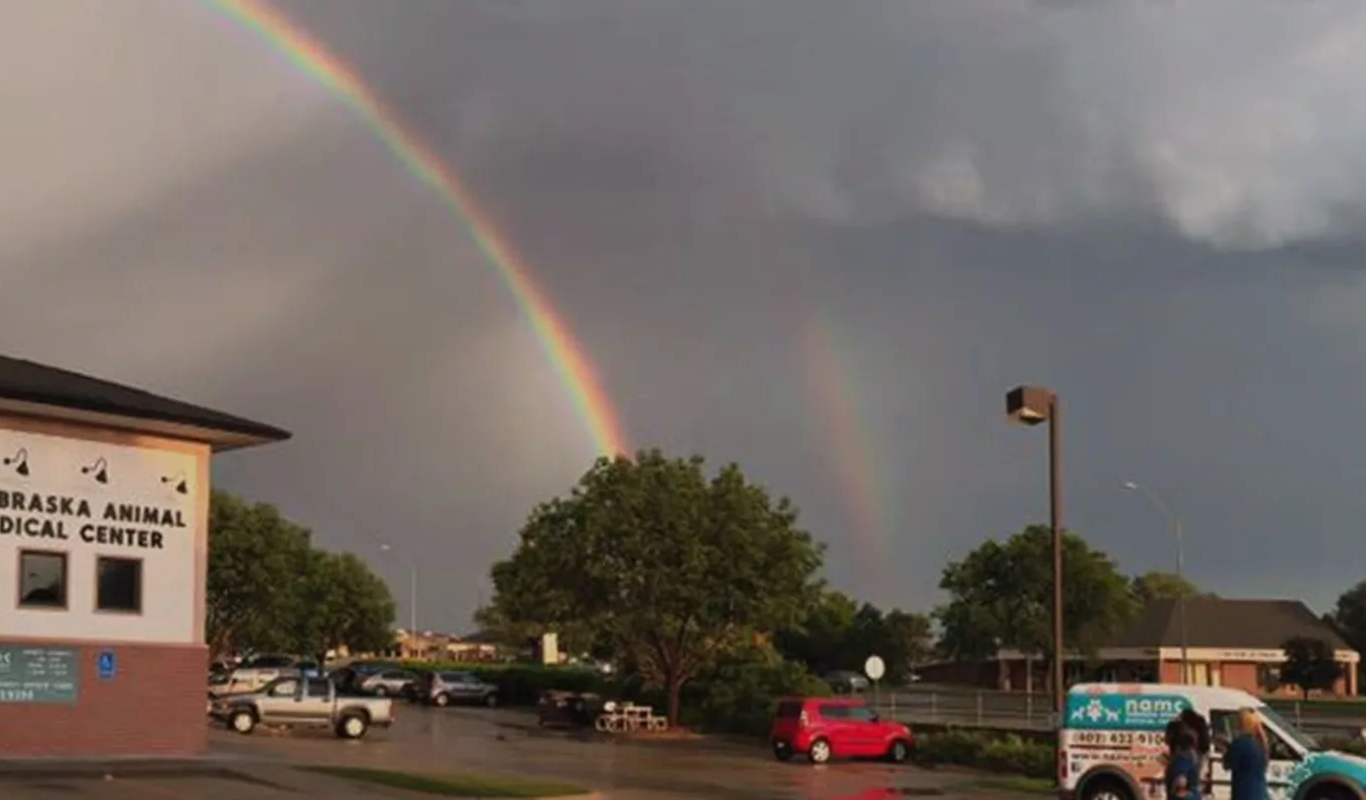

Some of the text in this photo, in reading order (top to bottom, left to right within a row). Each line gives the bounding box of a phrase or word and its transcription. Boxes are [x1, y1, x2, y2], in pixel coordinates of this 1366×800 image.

[103, 502, 187, 528] ANIMAL
[79, 524, 164, 549] CENTER
[1125, 699, 1186, 713] namc
